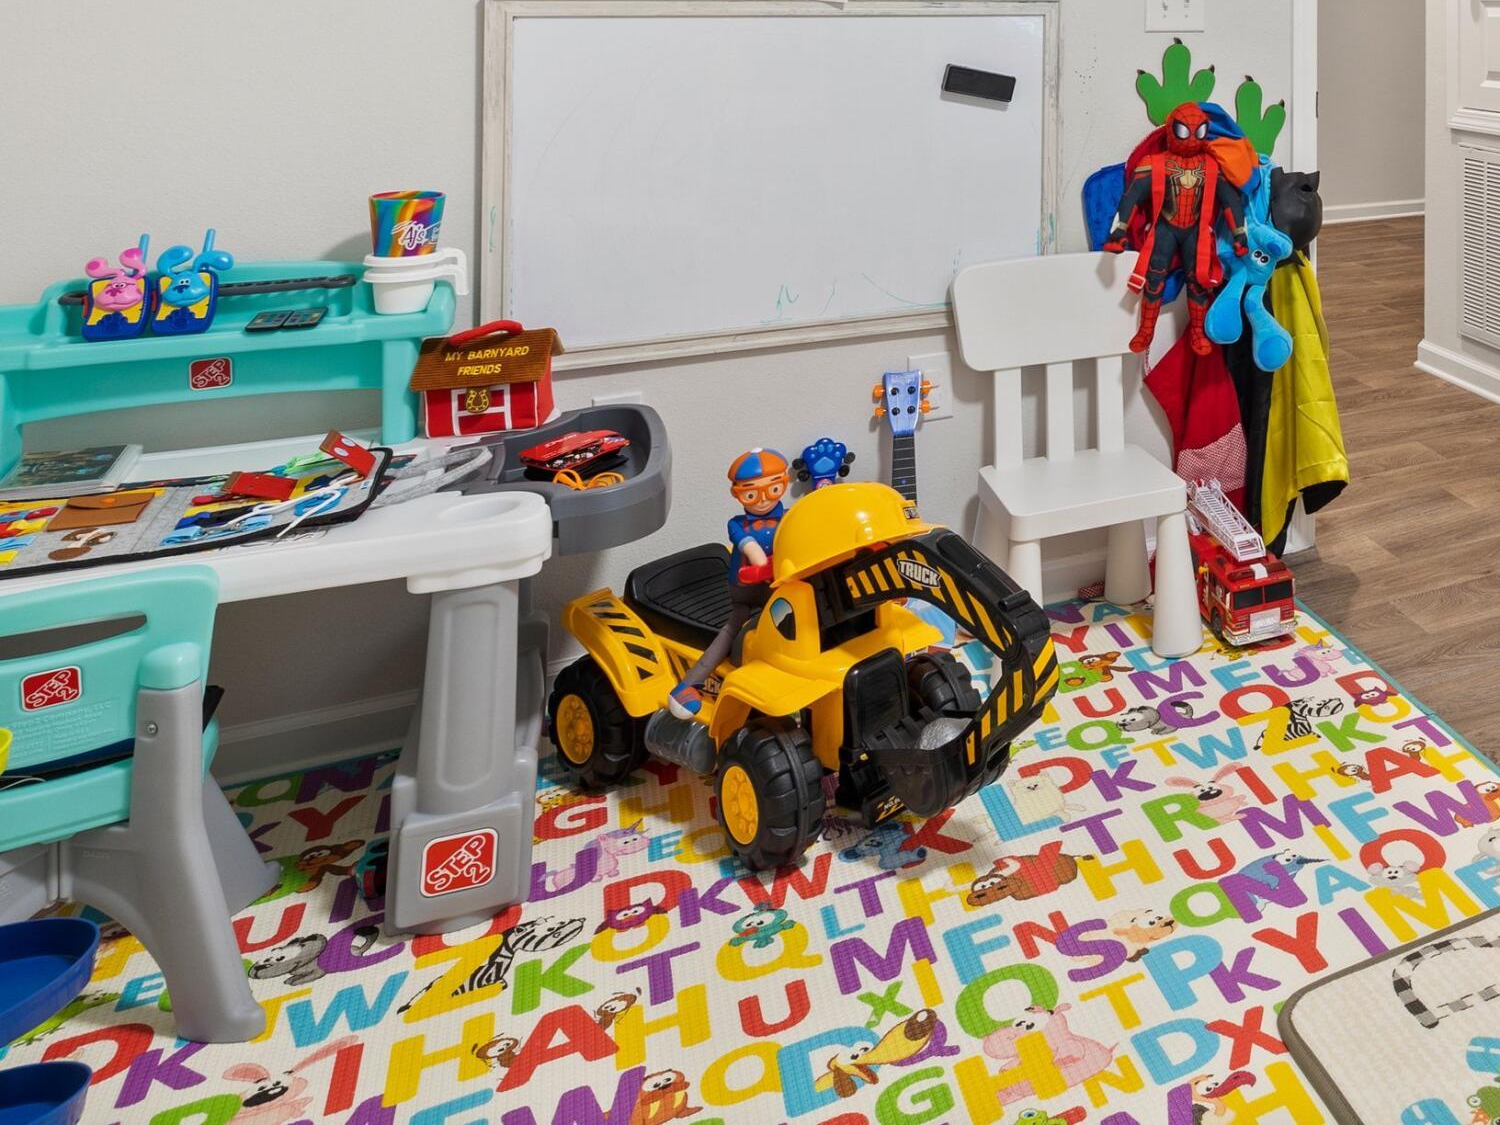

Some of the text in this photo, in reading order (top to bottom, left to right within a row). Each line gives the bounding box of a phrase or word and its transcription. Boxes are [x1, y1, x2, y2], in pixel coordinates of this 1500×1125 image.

[192, 358, 225, 388] STEP
[445, 346, 530, 362] MY BARNYARD
[457, 363, 502, 376] FRIENDS
[214, 372, 230, 386] 2
[899, 560, 938, 586] TRUCK
[26, 670, 72, 707] STEP
[55, 686, 78, 701] 2
[1072, 687, 1127, 718] U
[1128, 659, 1207, 700] M
[1132, 735, 1178, 766] T
[1171, 727, 1247, 769] W
[1316, 712, 1387, 752] K
[1392, 716, 1453, 747] T
[1091, 759, 1156, 802] K
[1364, 747, 1441, 794] A
[1060, 808, 1123, 855] T
[1235, 794, 1331, 849] M
[1328, 792, 1389, 844] F
[1392, 780, 1492, 837] W
[426, 835, 486, 891] STEP
[463, 861, 490, 883] 2
[1075, 838, 1164, 901] H
[1172, 837, 1236, 880] U
[678, 876, 741, 929] K
[1315, 864, 1372, 906] A
[830, 916, 936, 995] M
[1251, 911, 1329, 974] Y
[511, 943, 594, 1015] K
[616, 941, 700, 1006] T
[1208, 946, 1282, 1004] K
[287, 970, 409, 1047] W
[738, 979, 810, 1037] U
[1078, 973, 1146, 1031] T
[381, 1012, 496, 1108] H
[496, 1004, 619, 1092] A
[1130, 1018, 1221, 1086] D
[114, 1042, 208, 1109] K
